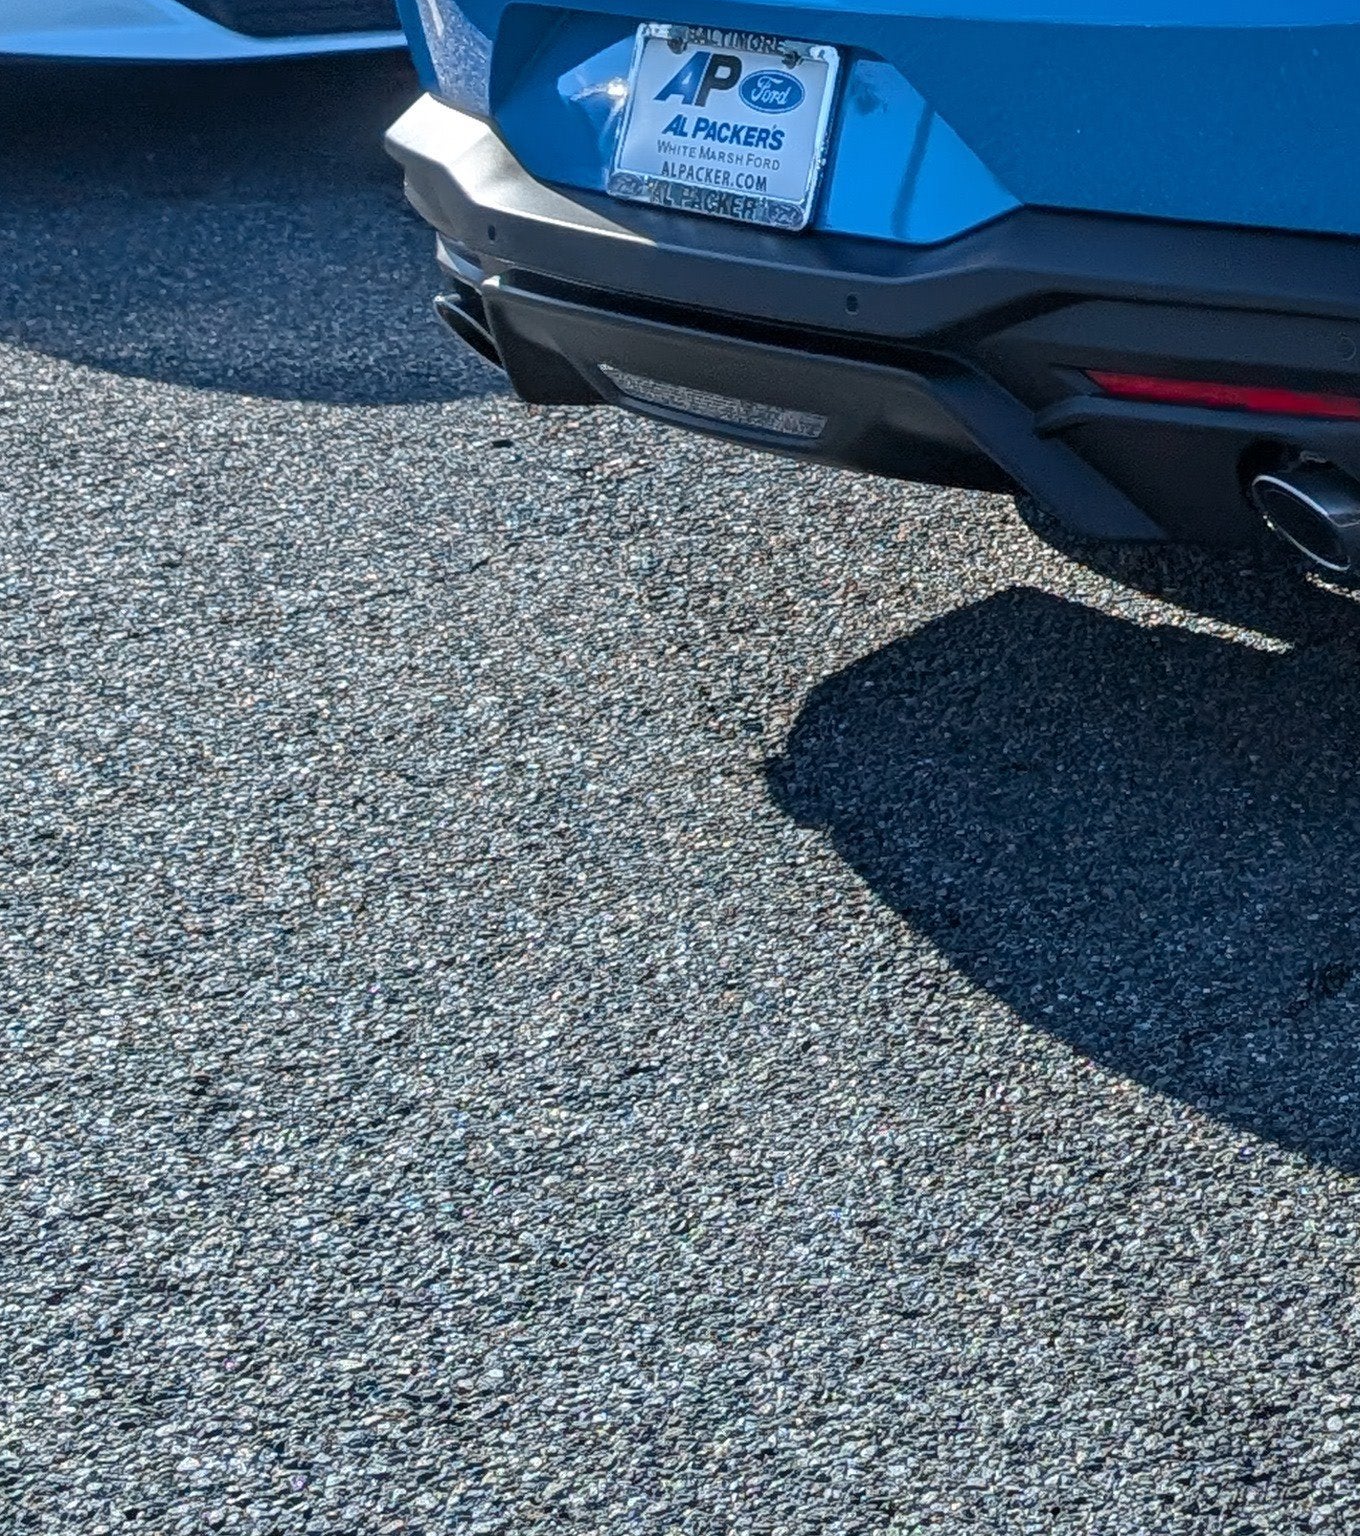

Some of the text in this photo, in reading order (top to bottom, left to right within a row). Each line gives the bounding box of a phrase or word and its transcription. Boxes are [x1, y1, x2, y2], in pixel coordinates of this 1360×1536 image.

[653, 50, 793, 108] AP Ford
[661, 113, 785, 151] AL PACKER'S
[660, 160, 768, 192] ALPACKER.COM
